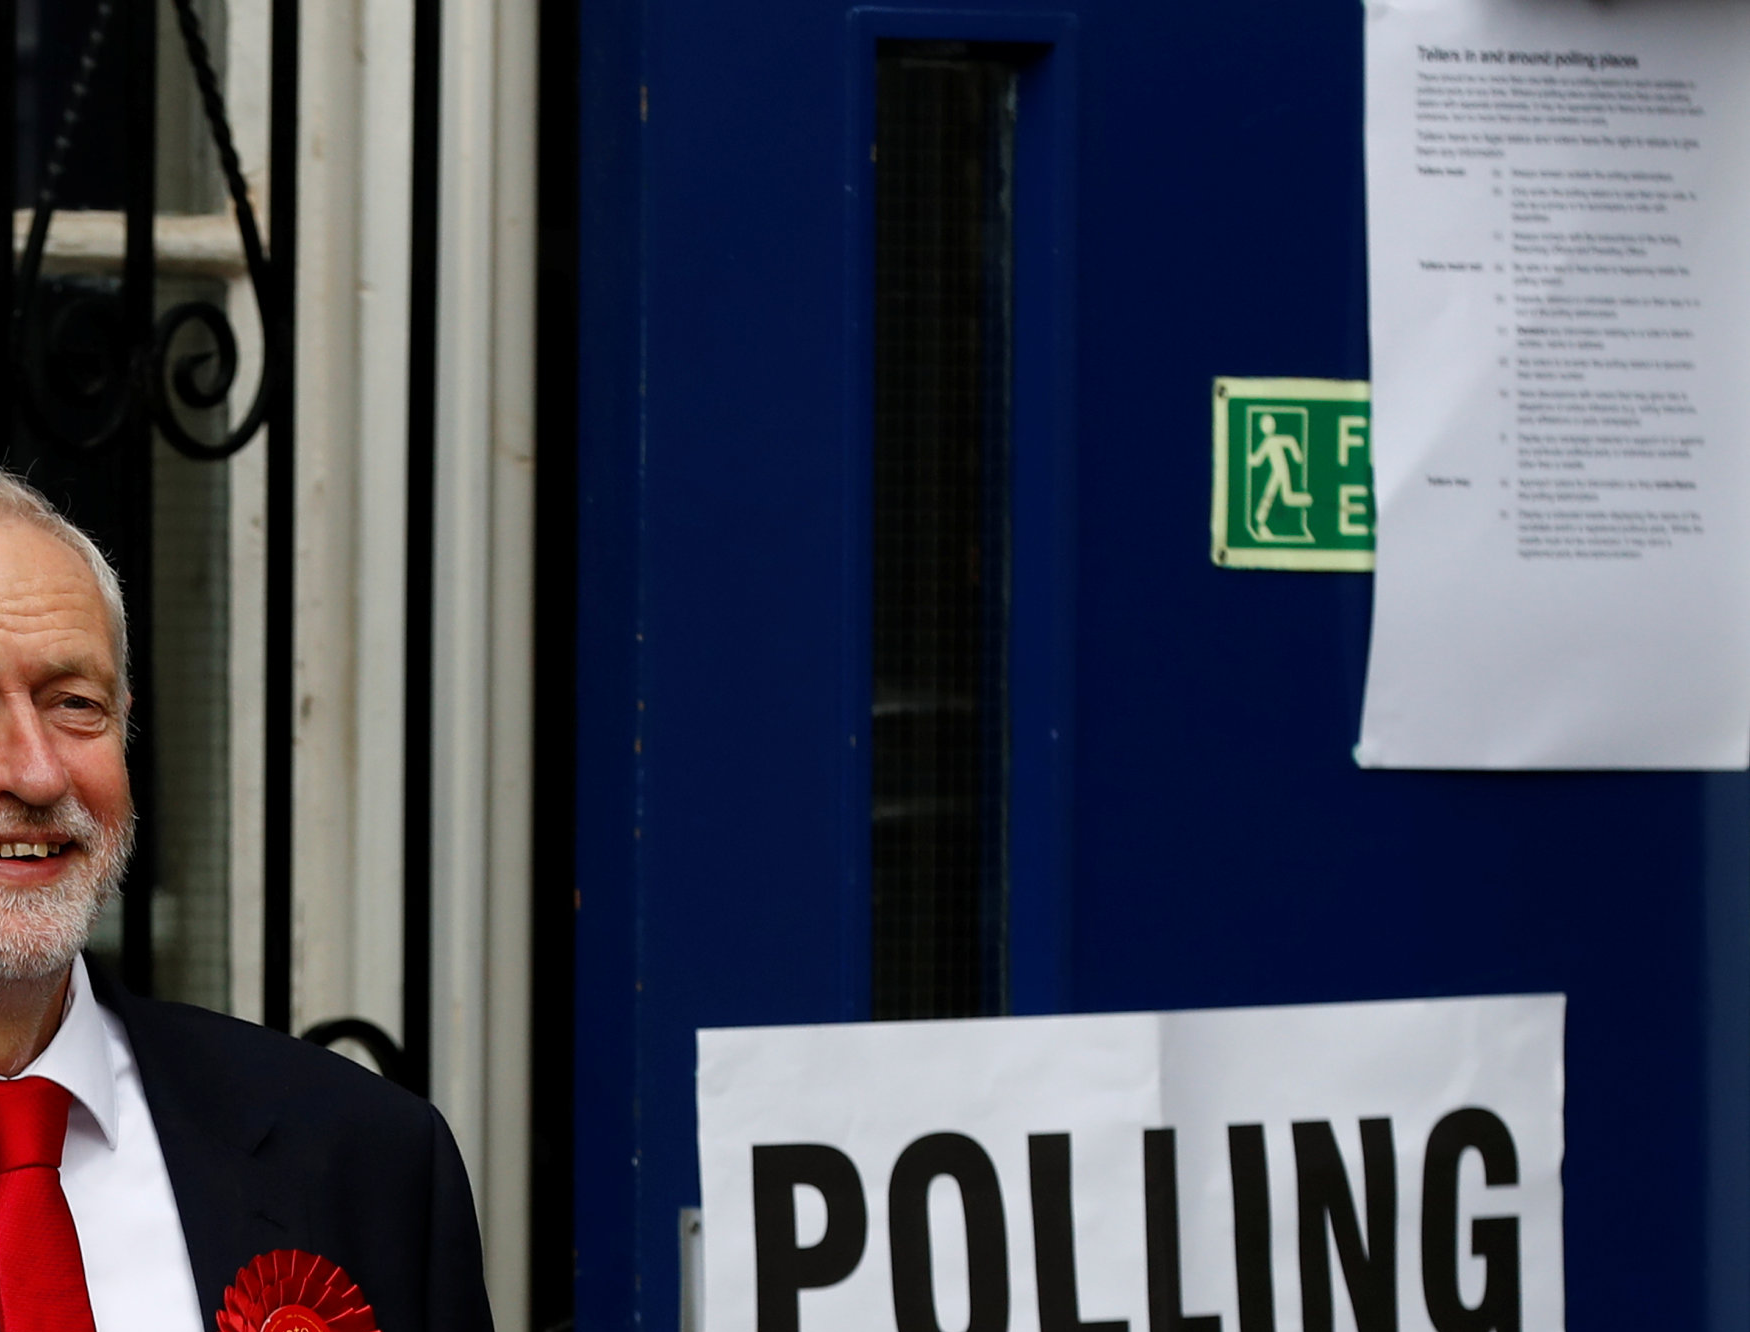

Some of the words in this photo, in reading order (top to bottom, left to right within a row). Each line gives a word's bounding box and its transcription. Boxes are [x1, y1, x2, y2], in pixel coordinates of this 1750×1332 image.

[1555, 51, 1596, 71] polling
[1338, 416, 1371, 467] F
[1338, 485, 1375, 536] E
